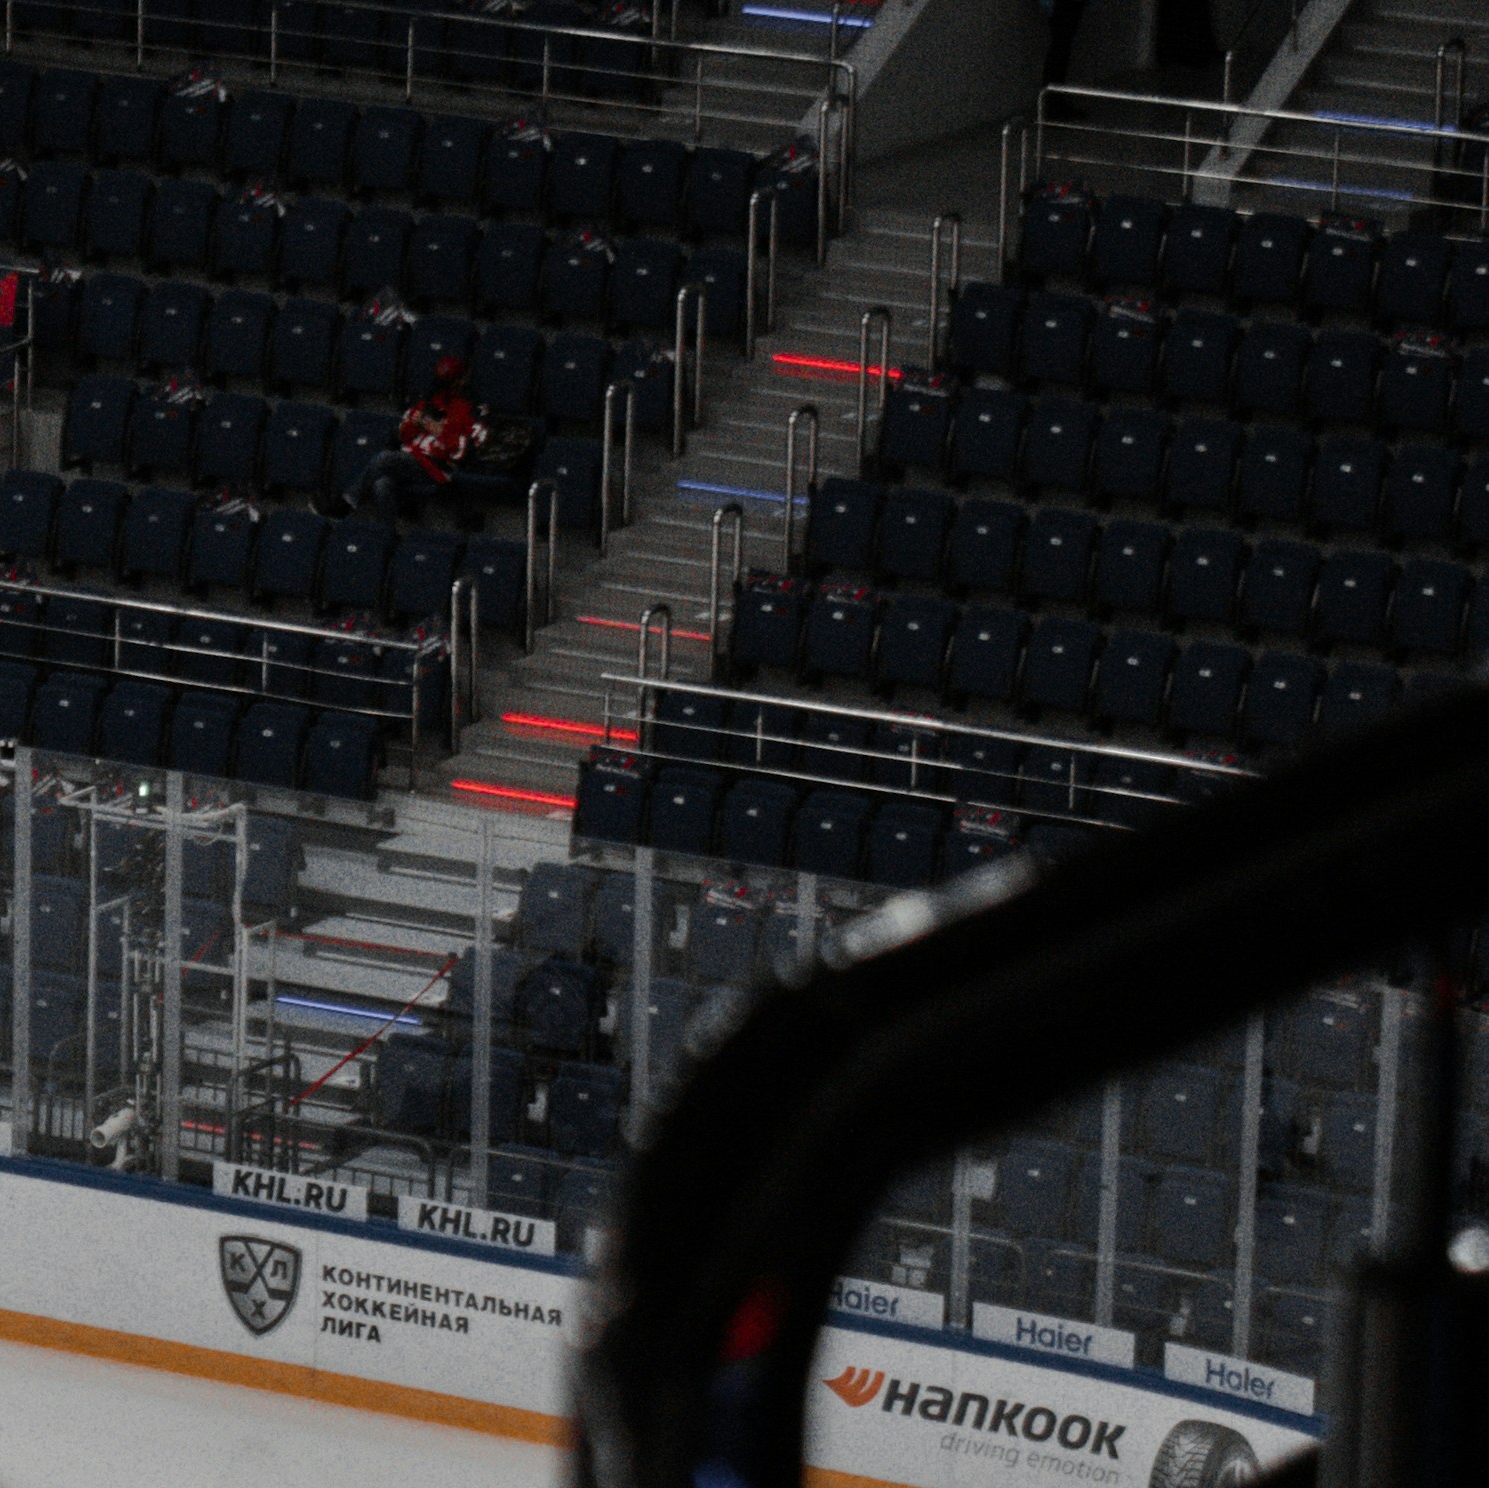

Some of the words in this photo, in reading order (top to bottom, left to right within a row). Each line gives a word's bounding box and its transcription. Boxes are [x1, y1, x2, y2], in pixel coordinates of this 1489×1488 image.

[232, 1168, 348, 1212] KHL.RU
[418, 1203, 535, 1248] KHL.RU
[322, 1264, 564, 1326] КОНТИНЕНТАЛЬНАЯ
[322, 1291, 470, 1335] ХОККЕЙНАЯ
[321, 1316, 382, 1343] ЛИГА
[1015, 1317, 1093, 1354] Haier
[940, 1431, 1021, 1468] driving
[1026, 1449, 1120, 1485] emotion
